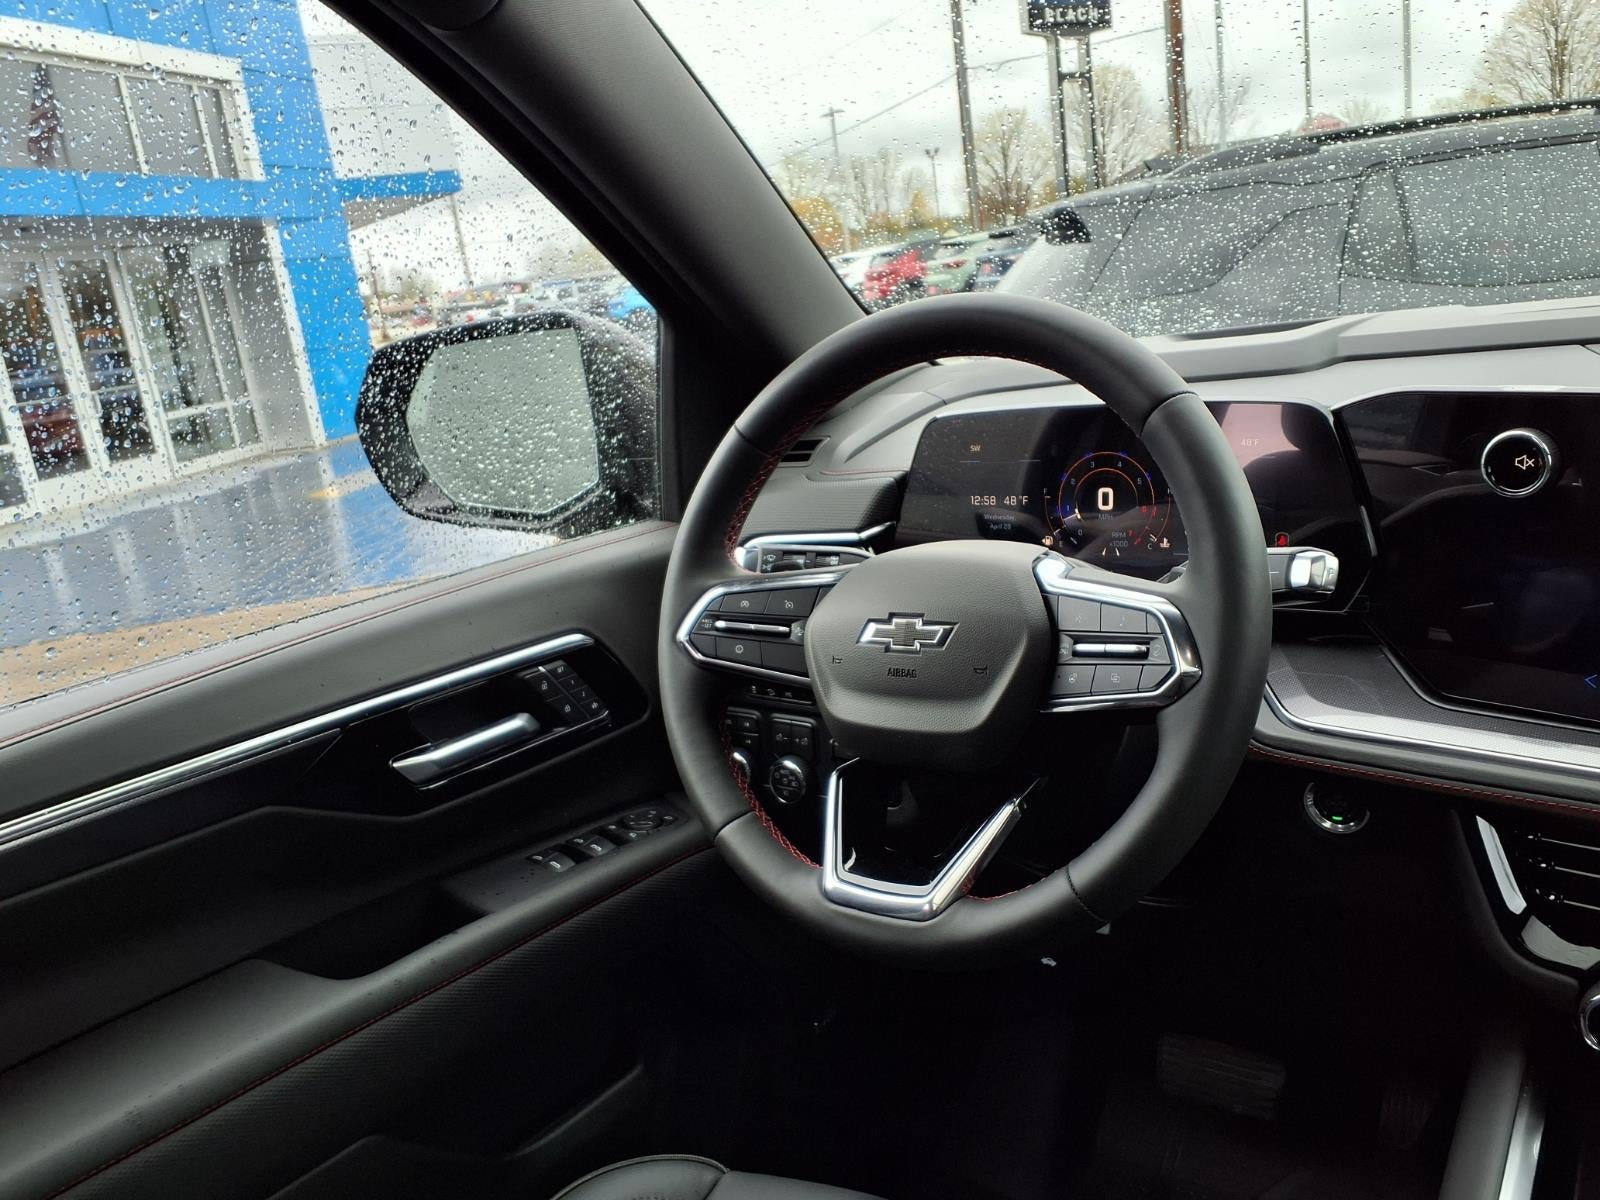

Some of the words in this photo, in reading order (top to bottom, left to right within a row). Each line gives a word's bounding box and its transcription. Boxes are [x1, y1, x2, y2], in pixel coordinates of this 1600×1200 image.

[970, 495, 997, 506] 12:58
[1097, 487, 1114, 511] 0
[887, 667, 918, 679] AIRBAG
